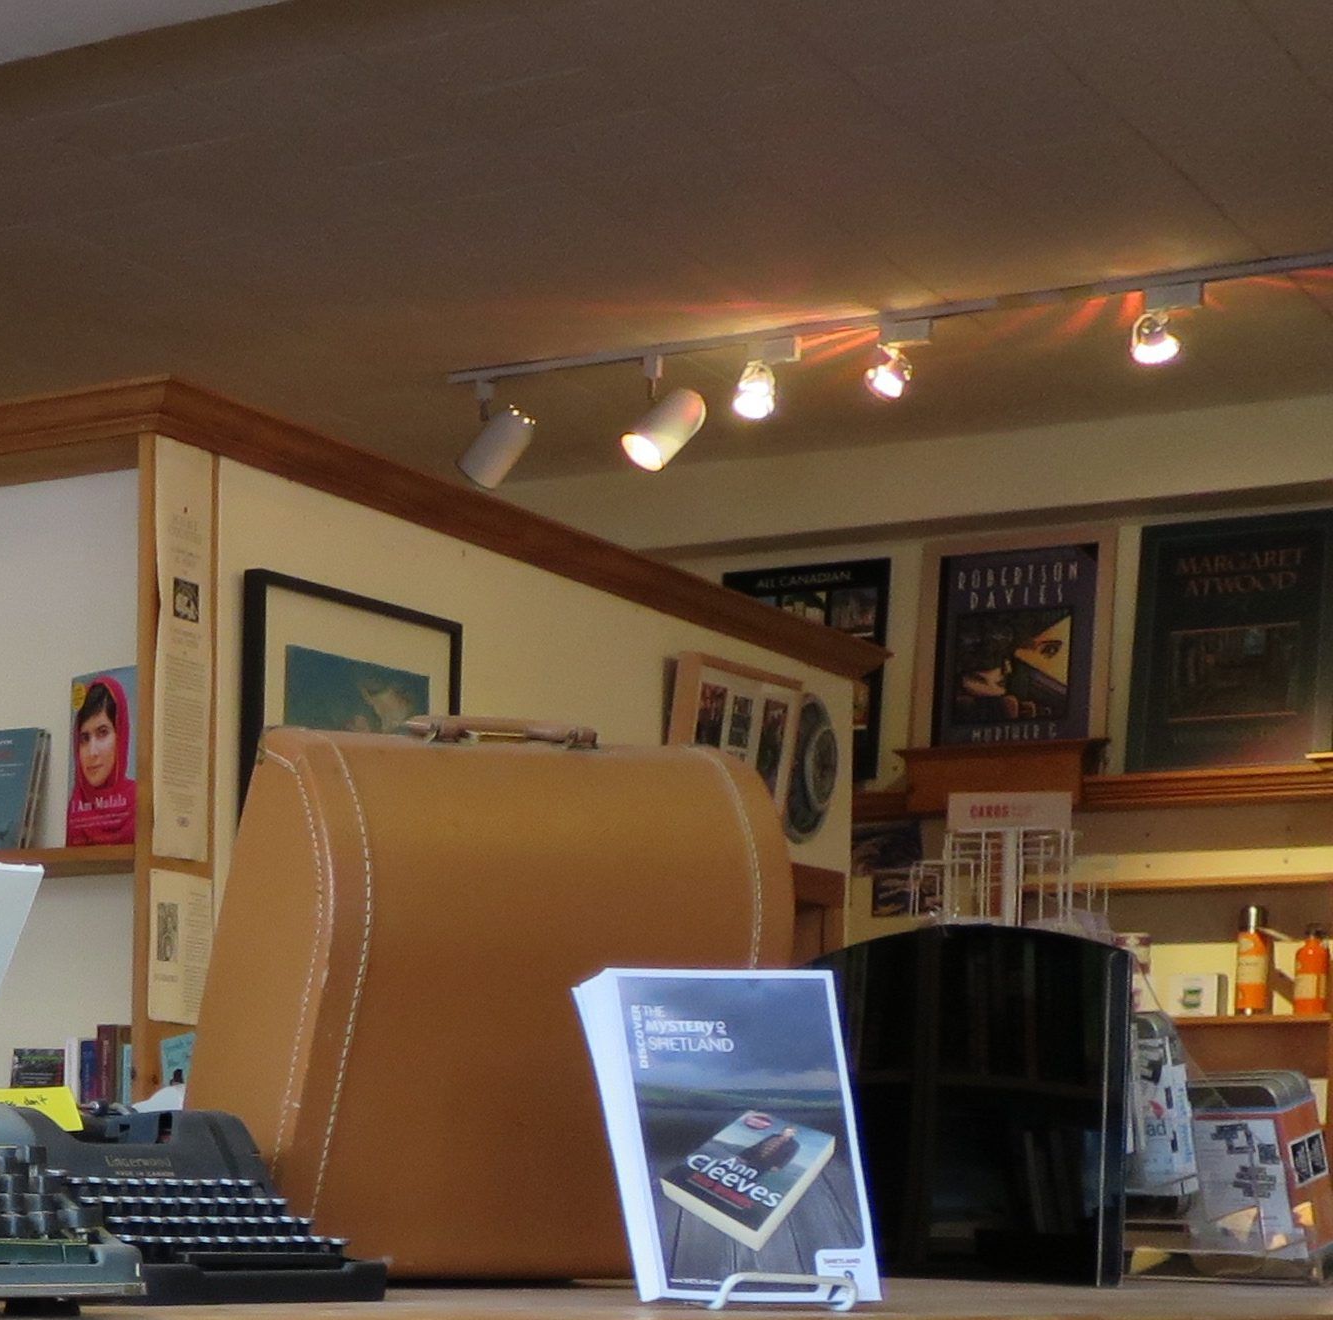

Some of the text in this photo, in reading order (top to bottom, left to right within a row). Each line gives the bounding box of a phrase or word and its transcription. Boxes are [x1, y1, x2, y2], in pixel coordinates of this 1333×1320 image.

[1177, 549, 1302, 574] MARGARET
[778, 570, 851, 587] CANADIAN
[958, 561, 1079, 592] ROBERTSON
[1185, 572, 1297, 597] ATWOOD
[969, 587, 1063, 610] DAVIES
[95, 795, 127, 809] Malala
[648, 1038, 734, 1052] SHETLAND
[722, 1156, 759, 1178] Ann
[687, 1153, 783, 1208] Cleeves
